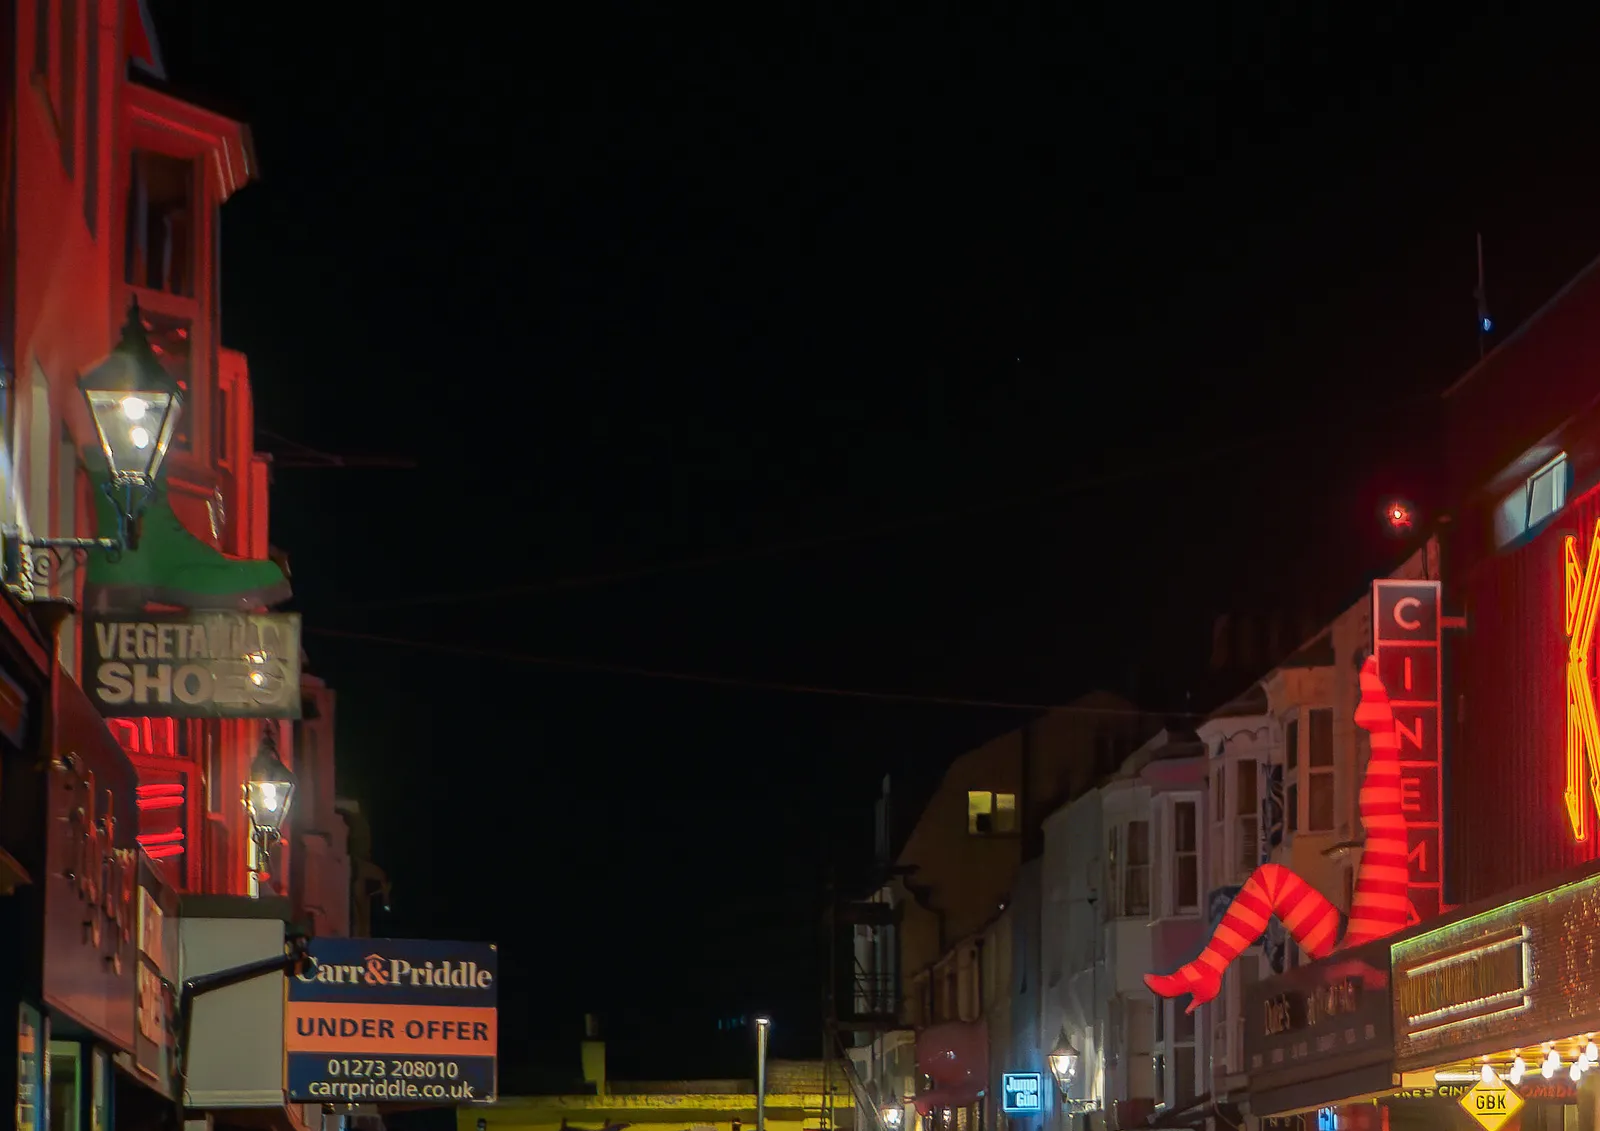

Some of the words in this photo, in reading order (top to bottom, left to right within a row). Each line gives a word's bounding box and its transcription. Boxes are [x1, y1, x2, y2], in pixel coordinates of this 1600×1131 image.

[96, 661, 284, 705] SHOES
[296, 1016, 395, 1039] UNDER
[405, 1019, 489, 1041] OFFER
[328, 1059, 385, 1077] 01273
[390, 1060, 458, 1078] 208010
[308, 1079, 474, 1100] carrpriddle.co.uk
[1006, 1076, 1038, 1093] Jump
[1476, 1095, 1507, 1110] GBK
